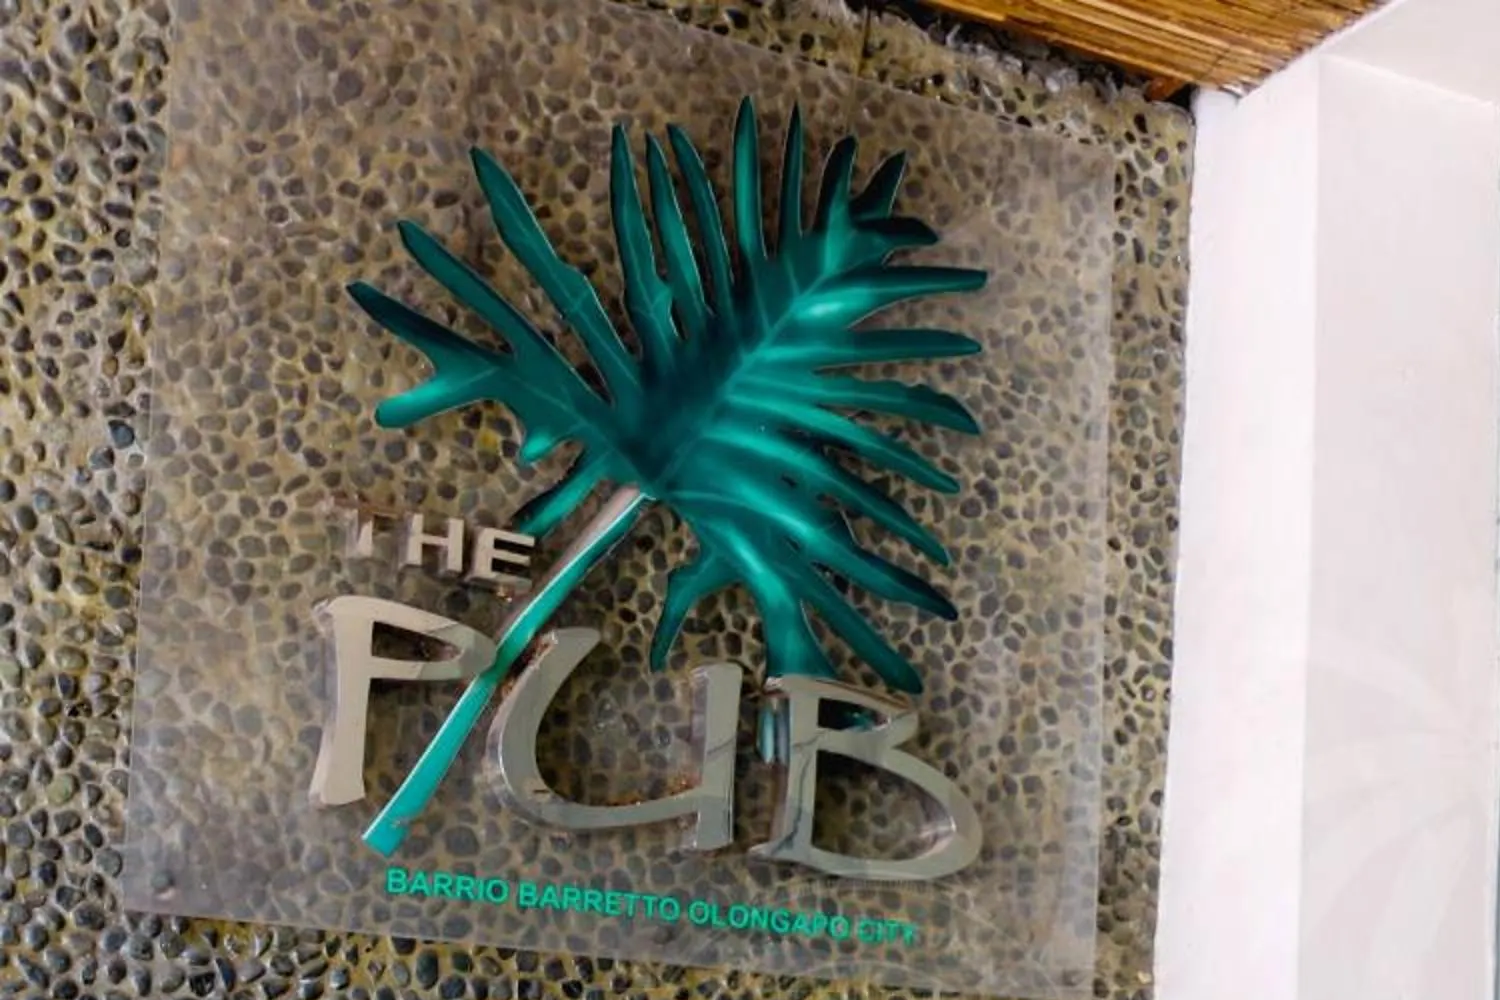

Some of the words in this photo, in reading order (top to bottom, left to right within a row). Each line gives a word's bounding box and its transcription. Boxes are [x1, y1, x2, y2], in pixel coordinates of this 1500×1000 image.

[330, 492, 536, 588] THE
[308, 594, 984, 882] PUB
[386, 868, 508, 904] BARRIO
[518, 881, 680, 922] BARRETTO
[688, 900, 849, 940] OLONGAPO
[857, 917, 918, 946] CITY
